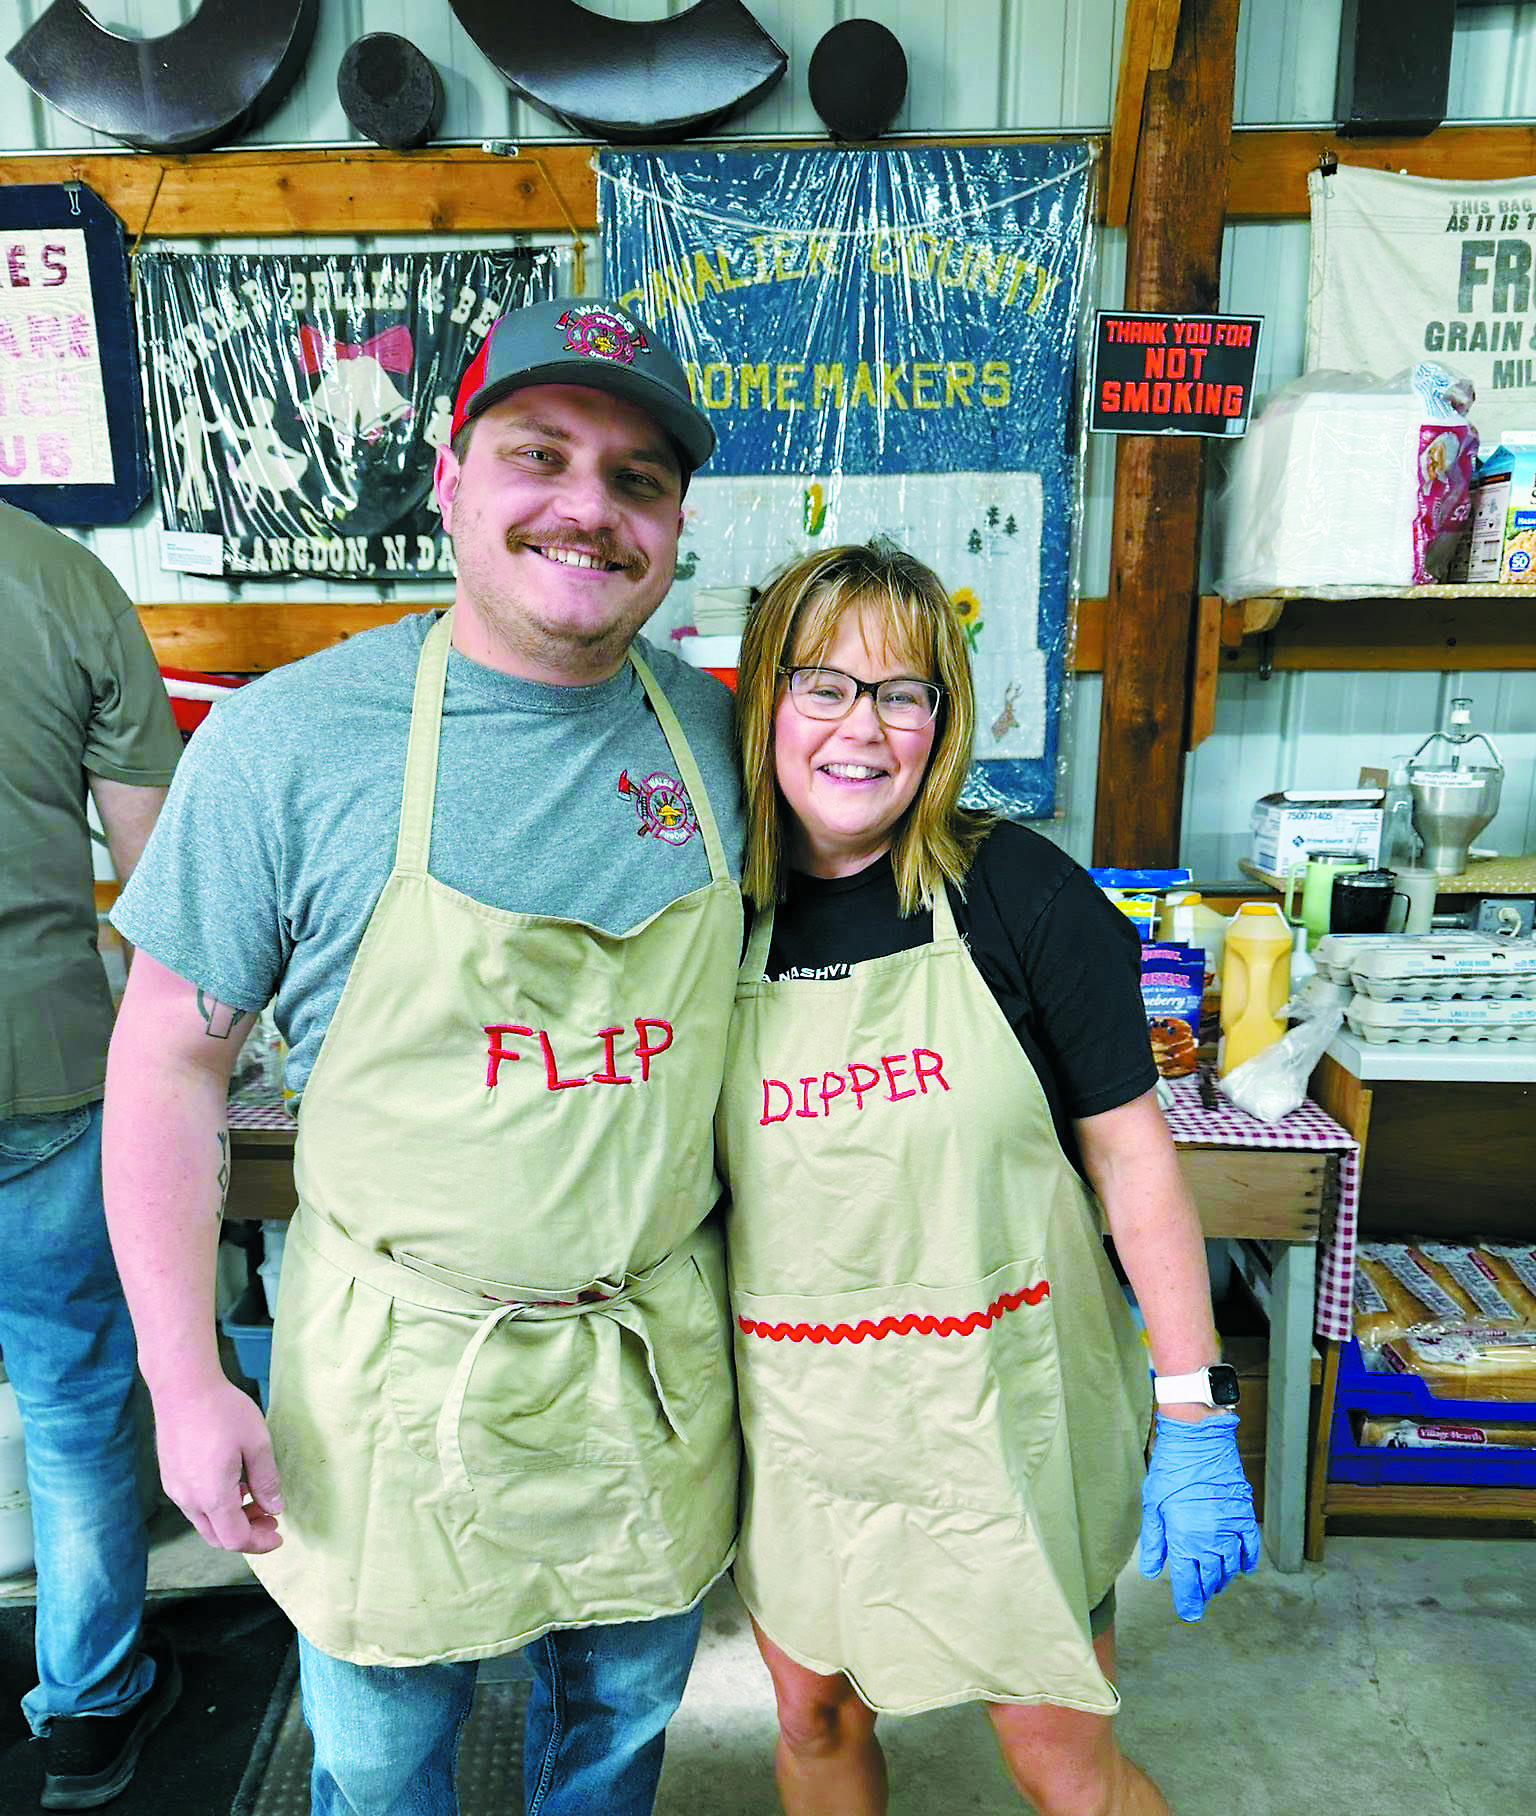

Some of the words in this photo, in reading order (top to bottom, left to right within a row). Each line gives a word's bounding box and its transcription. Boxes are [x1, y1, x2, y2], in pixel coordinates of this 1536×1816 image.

[1446, 215, 1469, 232] AS
[1476, 215, 1495, 232] IT
[1500, 213, 1519, 231] IS
[1450, 200, 1491, 215] THIS
[1499, 198, 1533, 213] BAG
[0, 244, 68, 288] ES
[870, 232, 1060, 317] COUNTY
[1457, 239, 1536, 313] FR
[291, 271, 410, 311] BELLES
[574, 304, 635, 334] WALES
[1105, 320, 1168, 345] THANK
[1172, 322, 1213, 345] YOU
[1214, 324, 1253, 348] FOR
[1424, 320, 1523, 352] GRAIN
[1144, 347, 1208, 380] NOT
[1101, 380, 1244, 417] SMOKING
[1511, 556, 1527, 568] 50
[483, 1017, 674, 1091] FLIP
[760, 1048, 951, 1126] DIPPER
[1420, 1428, 1450, 1441] Village
